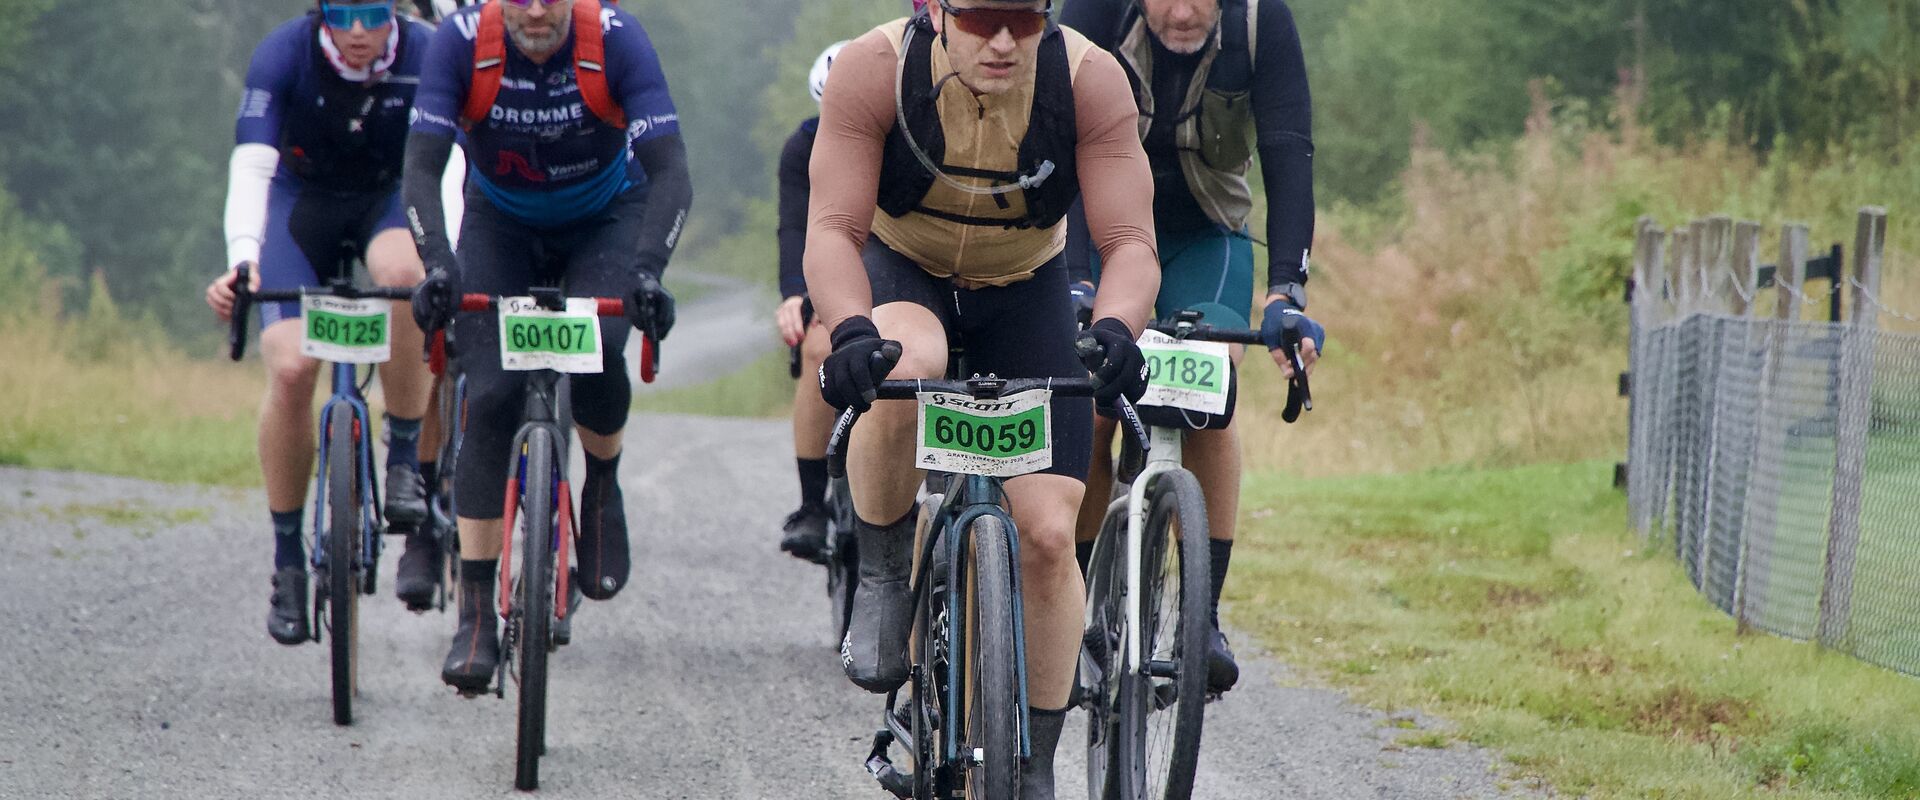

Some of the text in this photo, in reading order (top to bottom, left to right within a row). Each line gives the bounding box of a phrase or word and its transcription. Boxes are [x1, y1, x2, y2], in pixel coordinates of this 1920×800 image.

[313, 316, 381, 344] 60125
[511, 323, 587, 350] 60107
[1146, 355, 1215, 388] 0182
[947, 398, 1019, 412] SCOTT
[935, 415, 1036, 452] 60059
